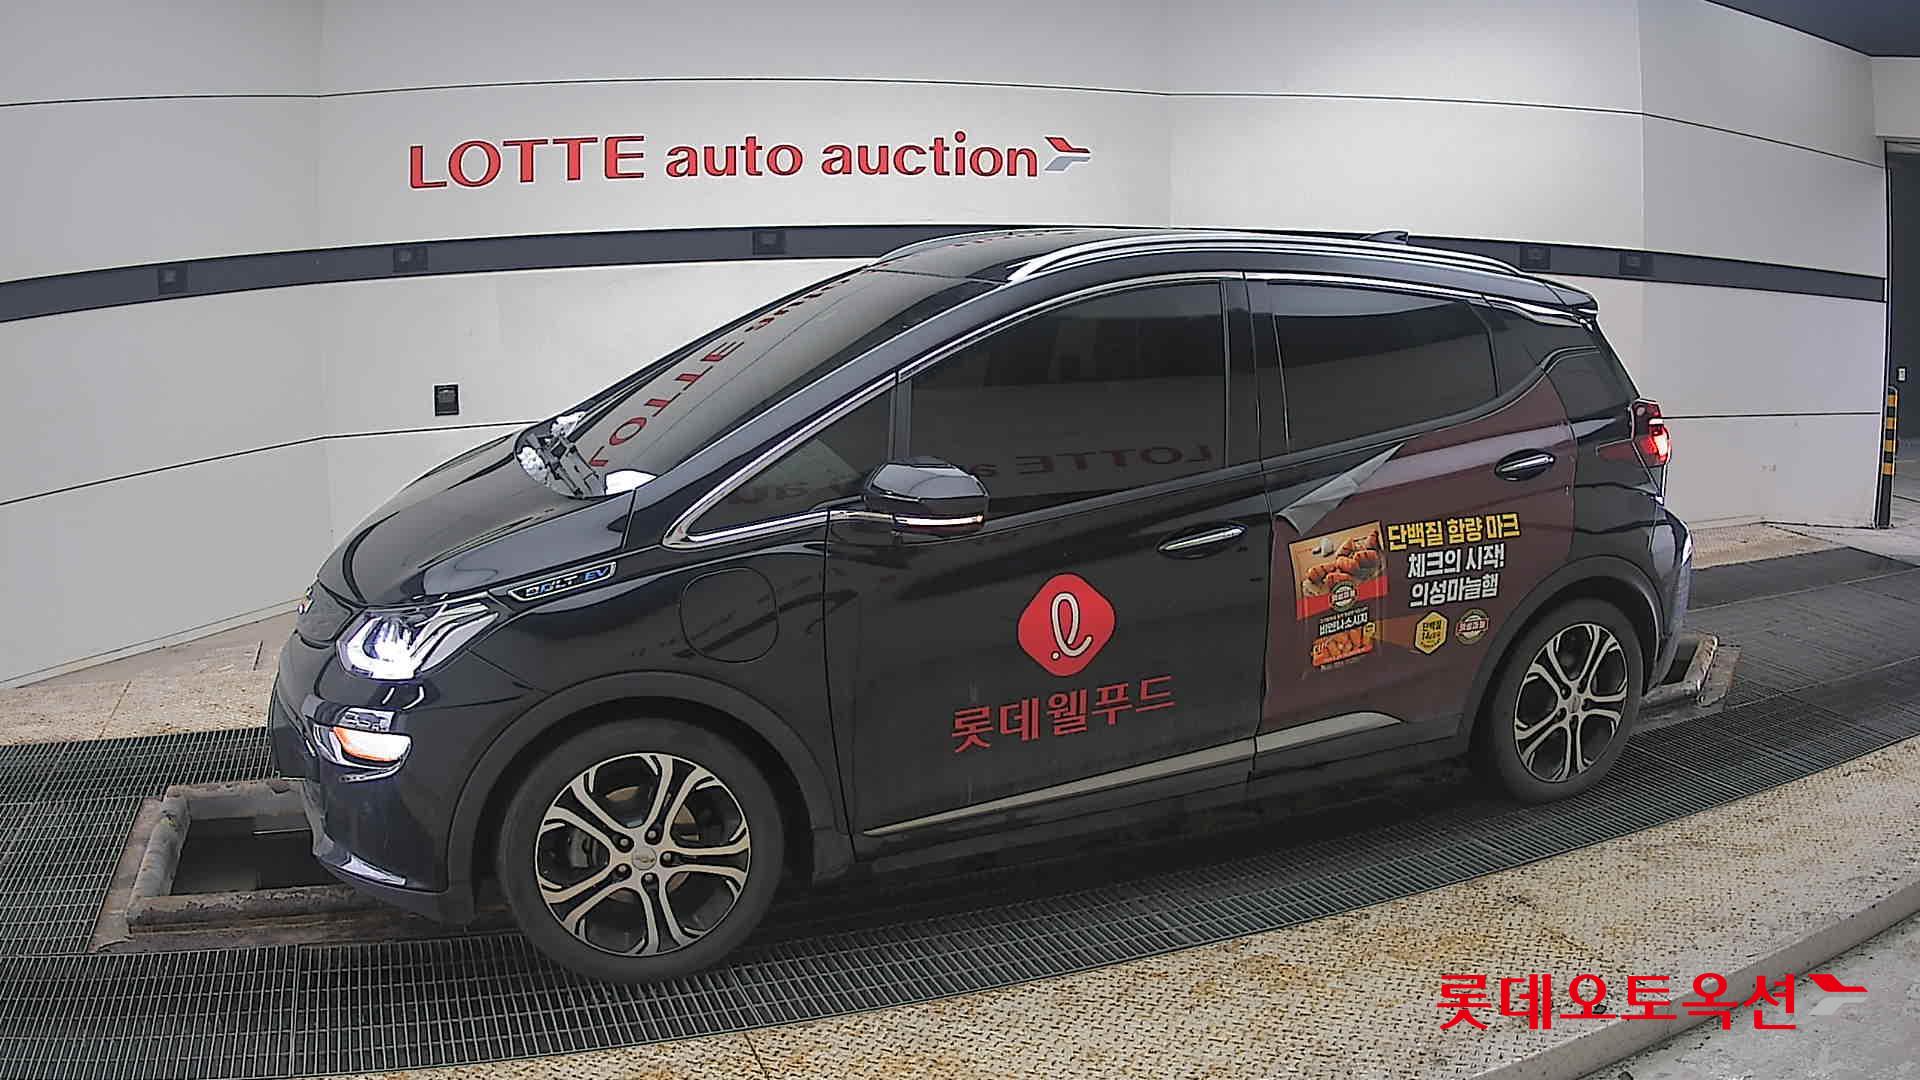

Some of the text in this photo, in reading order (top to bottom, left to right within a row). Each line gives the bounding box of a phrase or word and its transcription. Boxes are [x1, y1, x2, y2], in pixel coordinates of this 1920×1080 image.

[407, 131, 1039, 189] LOTTE auto auction
[1388, 512, 1521, 551] 단백질 함량 마크
[584, 567, 609, 581] EV
[1408, 543, 1505, 578] 체크의 시작!
[1409, 573, 1499, 608] 의성마늘햄
[951, 675, 1176, 753] 롯데웰푸드
